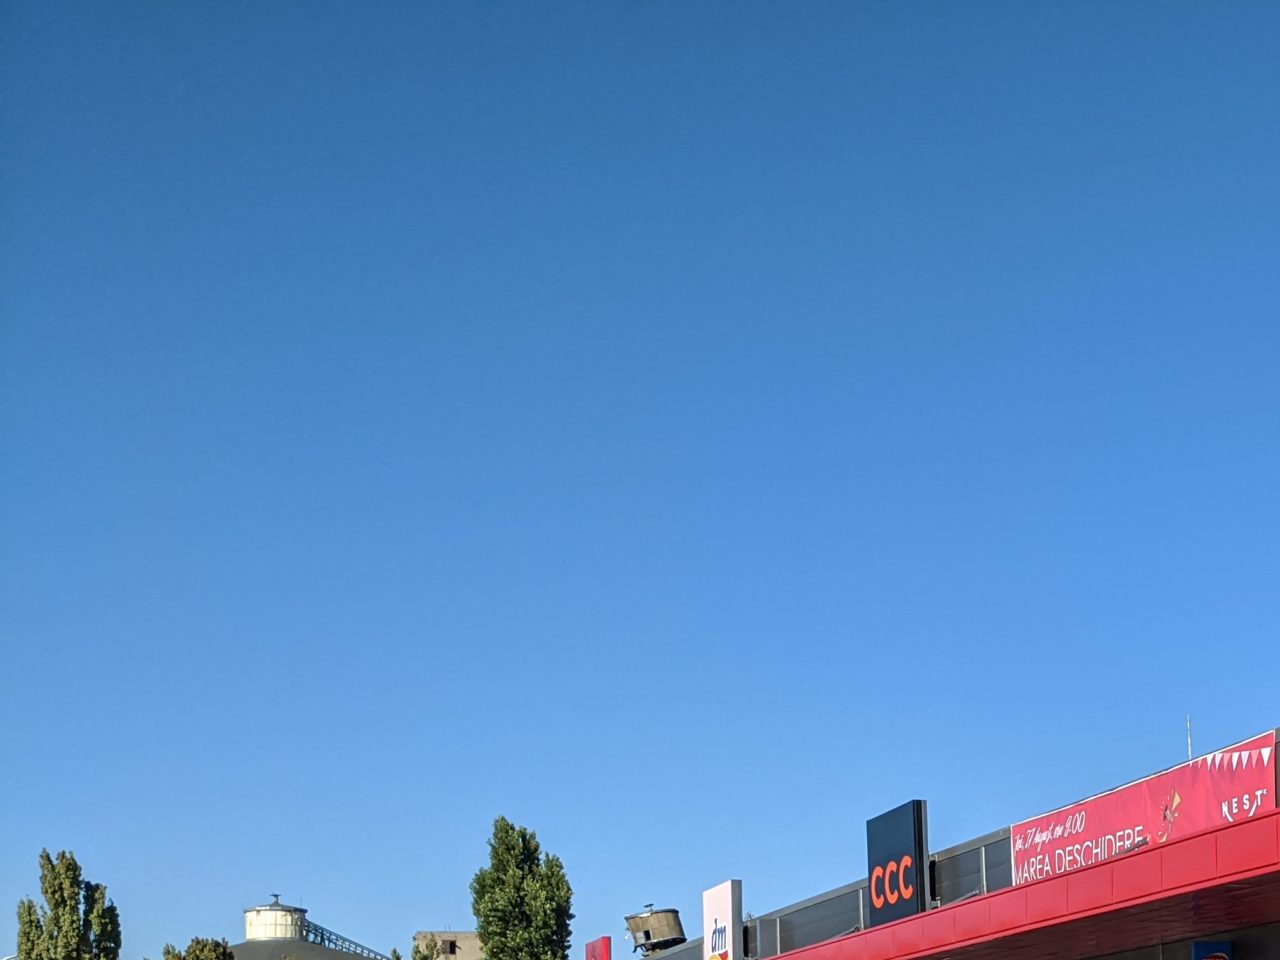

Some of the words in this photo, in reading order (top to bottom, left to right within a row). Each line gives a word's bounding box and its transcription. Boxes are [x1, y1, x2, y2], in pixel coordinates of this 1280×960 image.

[1222, 789, 1262, 822] NEST
[871, 855, 914, 909] CCC
[711, 919, 728, 953] dm
